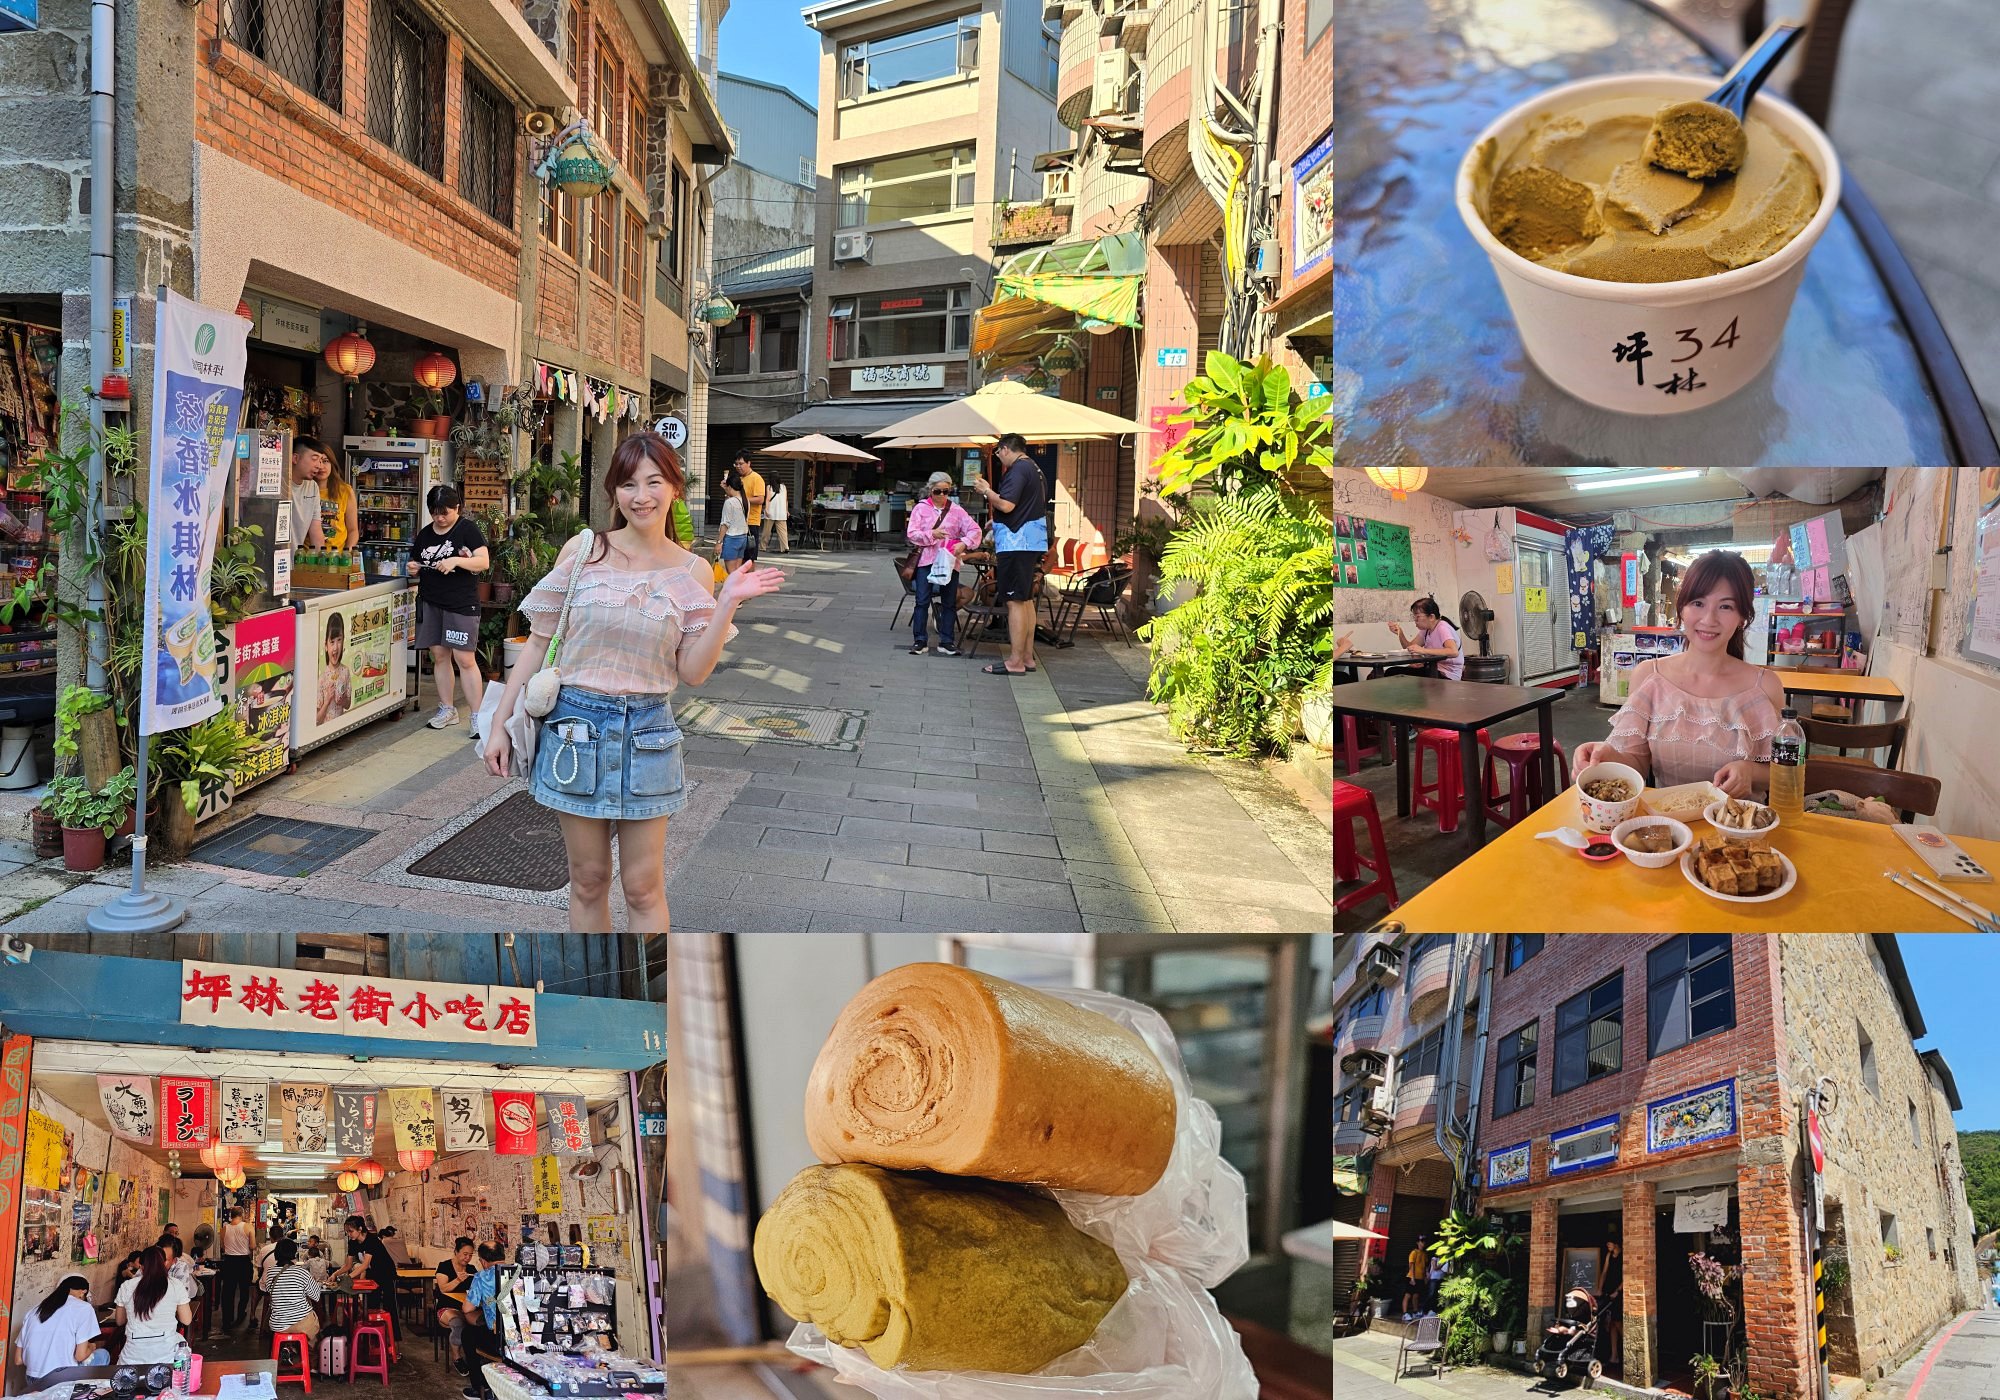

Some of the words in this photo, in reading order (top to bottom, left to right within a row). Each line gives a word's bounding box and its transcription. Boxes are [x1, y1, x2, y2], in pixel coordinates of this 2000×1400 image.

[1671, 315, 1741, 363] 34
[862, 363, 930, 382] 福長商號
[1170, 354, 1183, 365] 13
[350, 606, 389, 635] 茶香四溢
[446, 629, 469, 641] ROOTS
[182, 969, 531, 1035] 坪林老街小吃店
[176, 1087, 194, 1141] ラーメン
[447, 1096, 485, 1143] 努力
[559, 1101, 583, 1152] 準備中
[652, 1121, 665, 1133] 28
